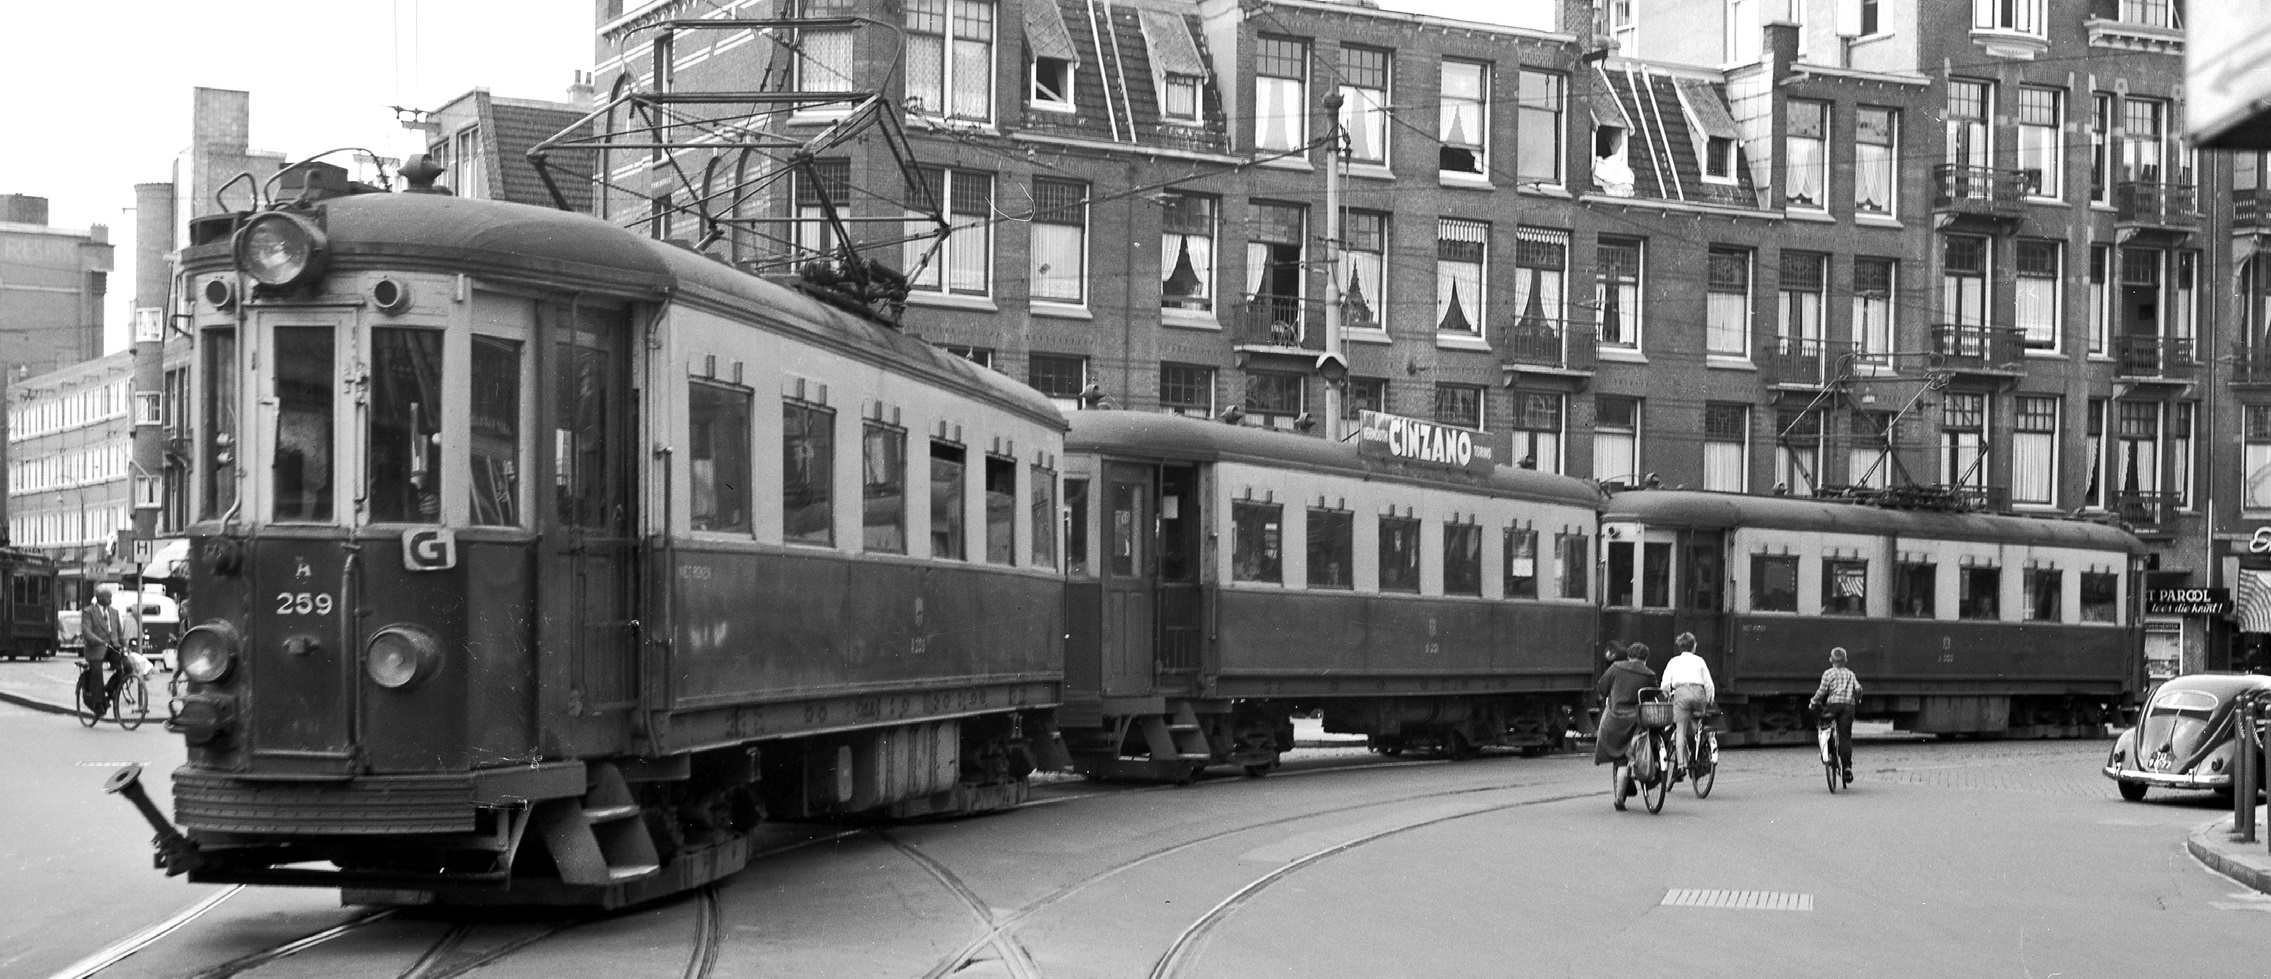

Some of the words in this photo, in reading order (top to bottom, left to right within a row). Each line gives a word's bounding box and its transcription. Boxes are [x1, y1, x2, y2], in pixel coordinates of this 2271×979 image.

[1388, 417, 1472, 467] CINZANO
[136, 541, 148, 556] H
[409, 531, 448, 567] G
[276, 592, 333, 615] 259
[2160, 589, 2211, 603] PAROOL
